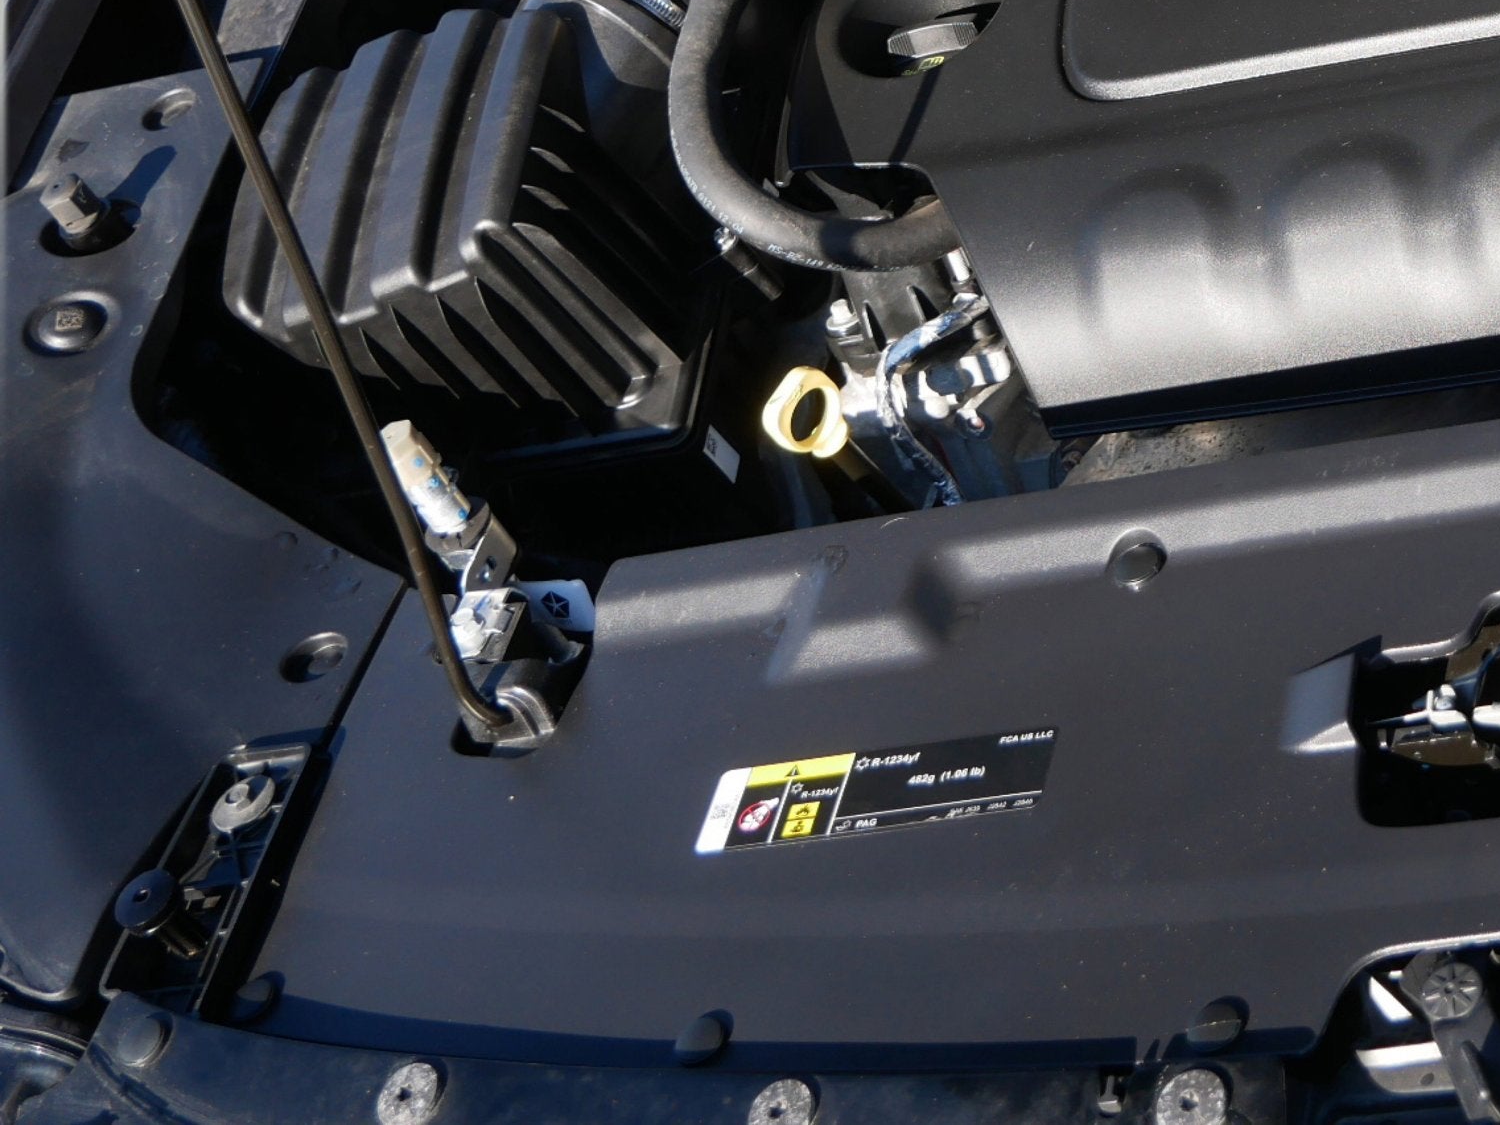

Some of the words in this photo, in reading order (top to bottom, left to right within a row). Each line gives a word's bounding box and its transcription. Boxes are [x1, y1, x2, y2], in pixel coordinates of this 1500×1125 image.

[999, 734, 1018, 745] FCA
[1020, 732, 1033, 742] US
[1035, 729, 1054, 740] LLC
[871, 751, 921, 768] R-1234yf
[970, 765, 985, 778] lb)
[855, 817, 878, 829] PAG
